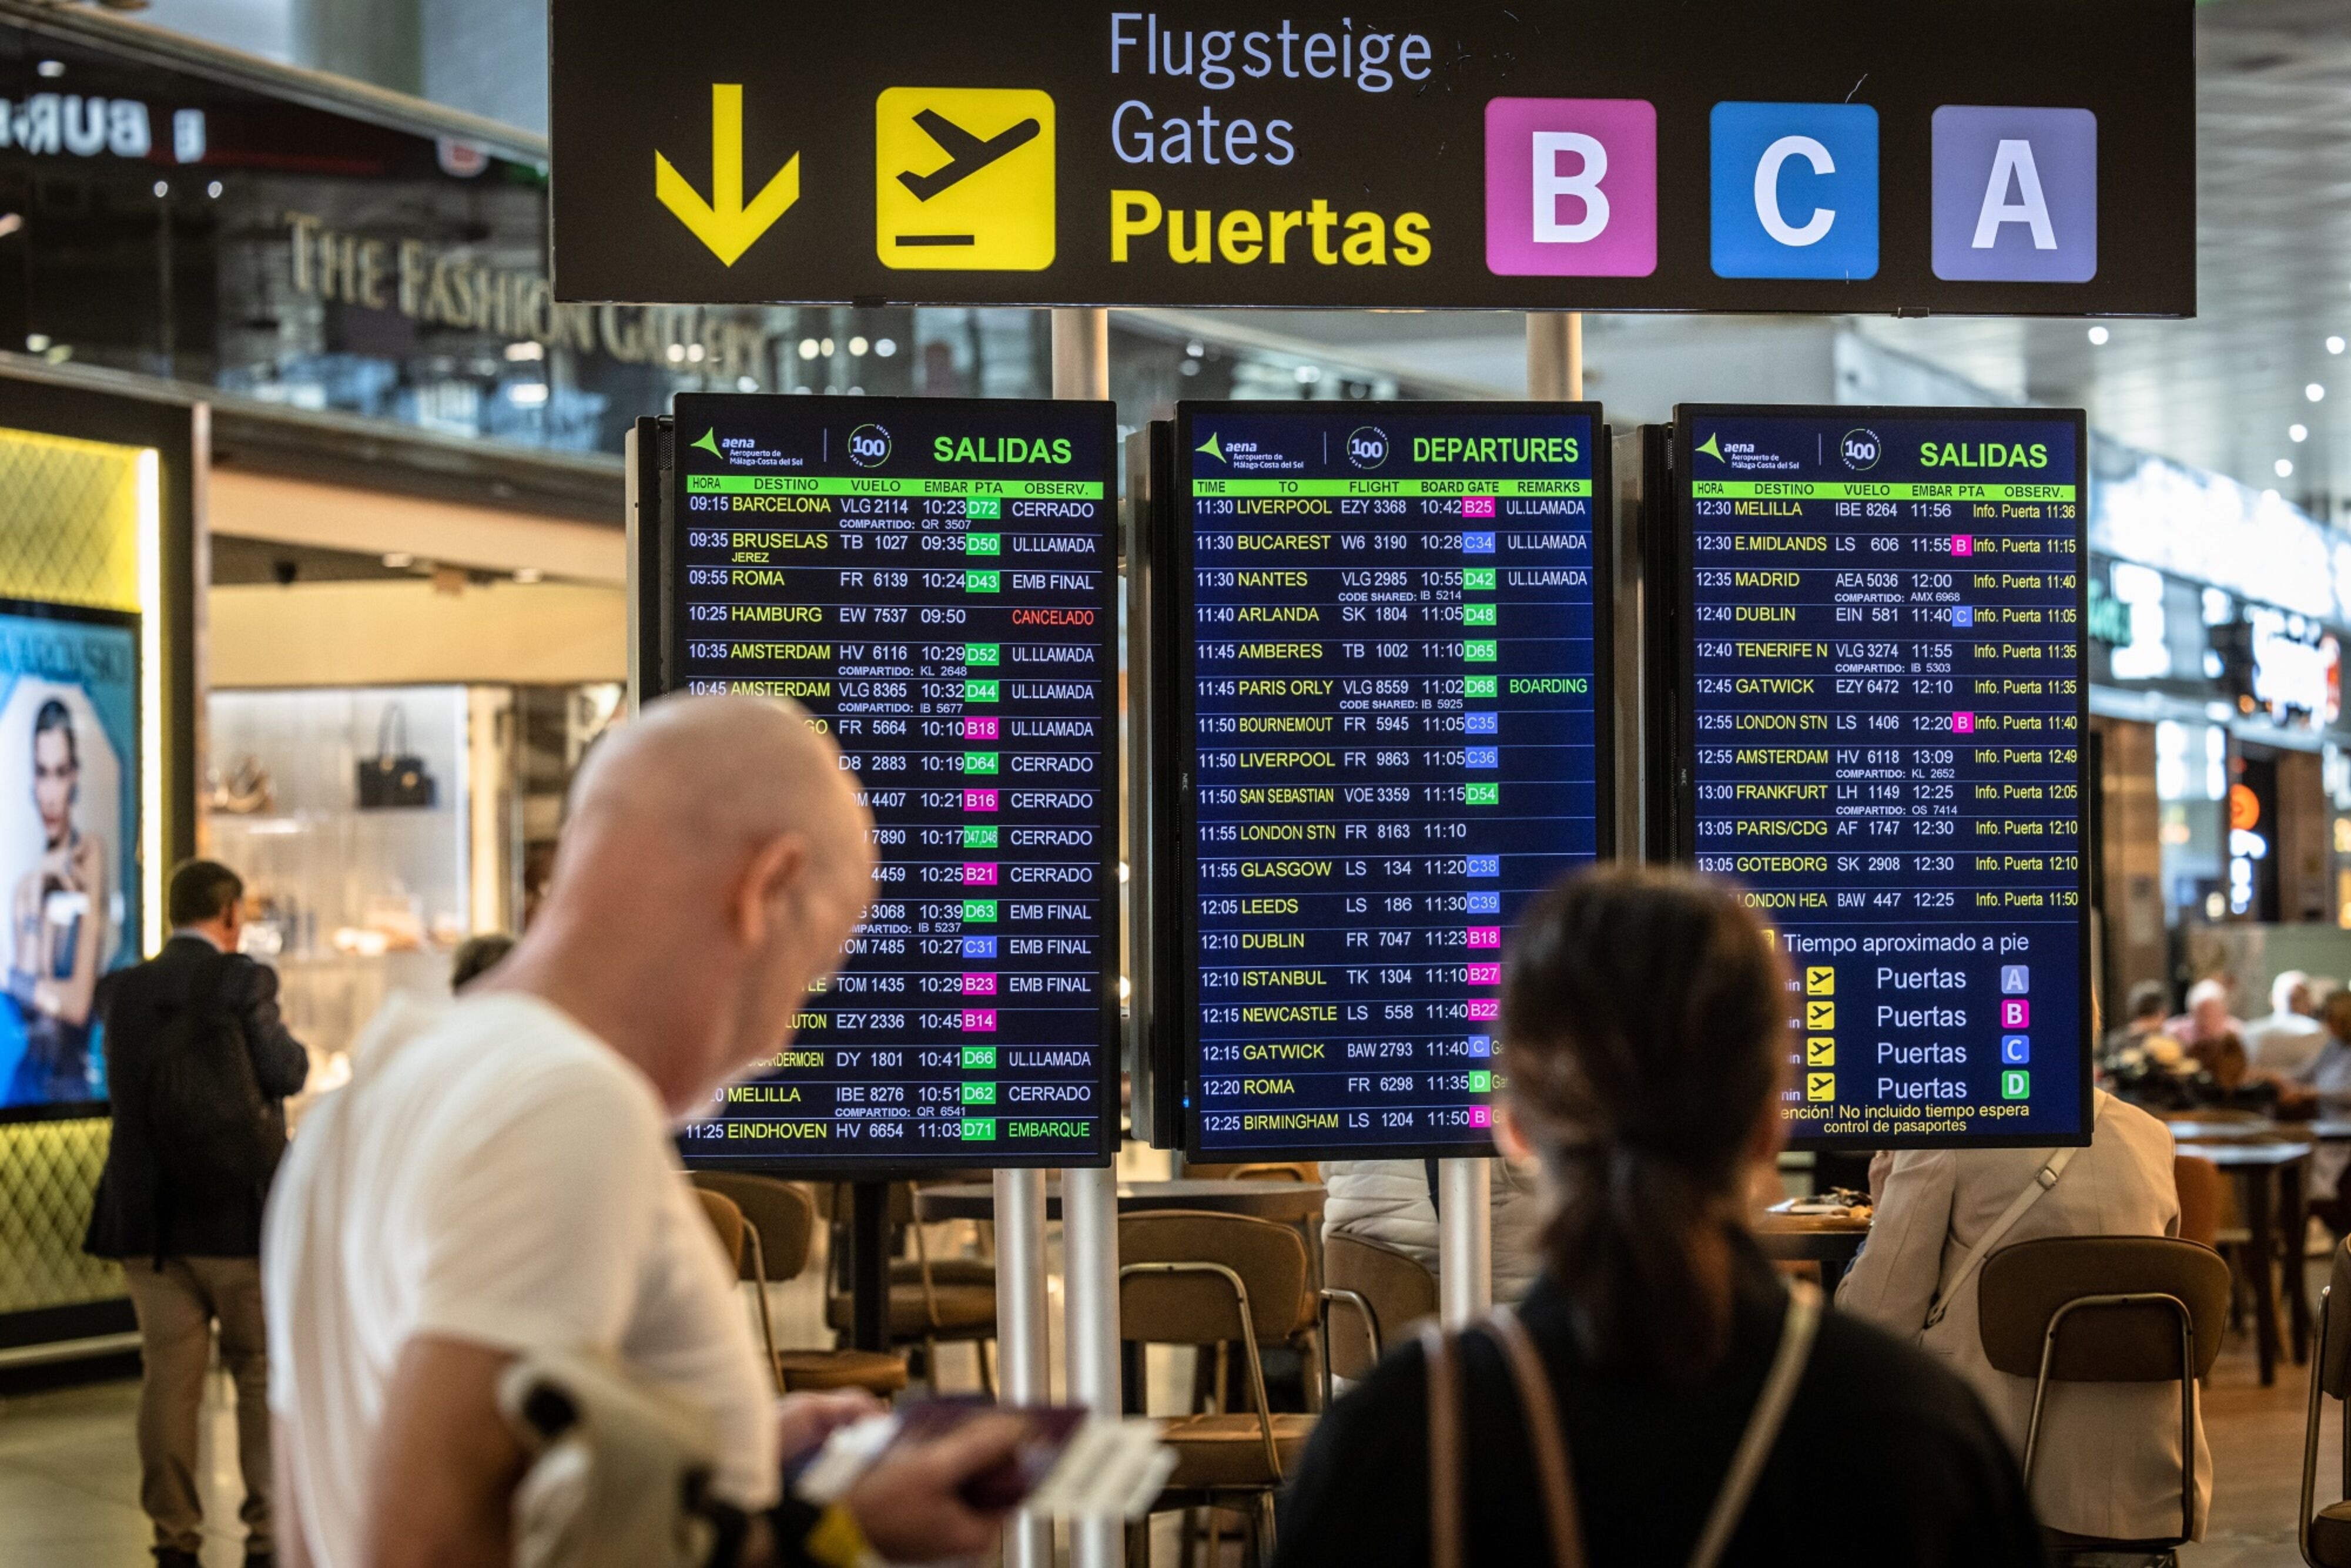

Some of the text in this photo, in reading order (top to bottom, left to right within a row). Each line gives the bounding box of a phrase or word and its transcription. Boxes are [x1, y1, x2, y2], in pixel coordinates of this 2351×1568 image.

[1111, 12, 1431, 92] Flugsteige
[1111, 100, 1294, 165] Gates
[1532, 131, 1610, 243] B
[1754, 136, 1835, 246] C
[1971, 139, 2058, 250] A
[1110, 189, 1431, 266] Puertas
[722, 438, 755, 448] aena
[851, 436, 885, 457] 100
[934, 437, 1071, 464] SALIDAS
[1225, 443, 1257, 452] aena
[1351, 438, 1383, 458] 100
[1414, 438, 1579, 463] DEPARTURES
[1724, 443, 1754, 453] aena
[1845, 440, 1876, 460] 100
[729, 449, 771, 458] Aeropuerto
[1233, 453, 1272, 461] Aeropuerto
[1920, 443, 2048, 468] SALIDAS
[692, 477, 1089, 495] HORA DESTINO VUELO EMBAR PTA OBSERV.
[1197, 481, 1580, 493] TIME TO FLIGHT BOARD GATE REMARKS
[1697, 483, 2064, 498] HORA DESTINO VUELO EMBAR PTA OBSERV.
[690, 496, 1094, 518] 09:15 BARCELONA VLG 2114 10:23 D72 CERRADO
[1197, 500, 1233, 514] 11:30
[1237, 499, 1332, 514] LIVERPOOL
[1341, 500, 1370, 514] EZY
[1374, 500, 1406, 514] 3368
[1421, 500, 1462, 514] 10:42
[1465, 501, 1492, 513] B25
[839, 519, 972, 530] COMPARTIDO: QR 3507
[689, 532, 728, 547] 09:35
[733, 532, 828, 549] BRUSELAS
[840, 534, 863, 549] TB
[875, 535, 908, 550] 1027
[922, 535, 966, 551] 09:35
[969, 538, 997, 551] D50
[1696, 536, 2077, 553] 12:30 E.MIDLANDS LS 606 11:55 B Info. Puerta 11:15
[731, 552, 769, 562] JEREZ
[689, 606, 1094, 625] 10:25 HAMBURG EW 7537 09:50 CANCELADO
[1198, 678, 1588, 695] 11:45 PARIS ORLY VLG 8559 11:02 D68 BOARDING
[1339, 699, 1463, 709] CODE SHARED: IB 5925
[1200, 823, 1466, 840] 11:55 LONDON STN FR 8163 11:10
[1698, 820, 2078, 835] 13:05 PARIS/CDG AF 1747 12:30 Info. Puerta 12:10
[1783, 933, 2029, 956] Tiempo aproximado a pie
[1878, 967, 2023, 990] Puertas A
[837, 1014, 867, 1028] EZY
[870, 1014, 905, 1028] 2336
[919, 1014, 962, 1028] 10:45
[966, 1014, 993, 1027] B14
[1203, 1003, 1498, 1023] 12:15 NEWCASTLE LS 558 11:40 B22
[1878, 1003, 2022, 1027] Puertas B
[1878, 1038, 2022, 1064] Puertas C
[1878, 1073, 2024, 1099] Puertas D
[1780, 1104, 2030, 1120] ención! No incluido tiempo espera
[684, 1122, 1090, 1138] 11:25 EINDHOVEN HV 6654 11:03 D71 EMBARQUE
[1824, 1120, 1967, 1135] control de pasaportes
